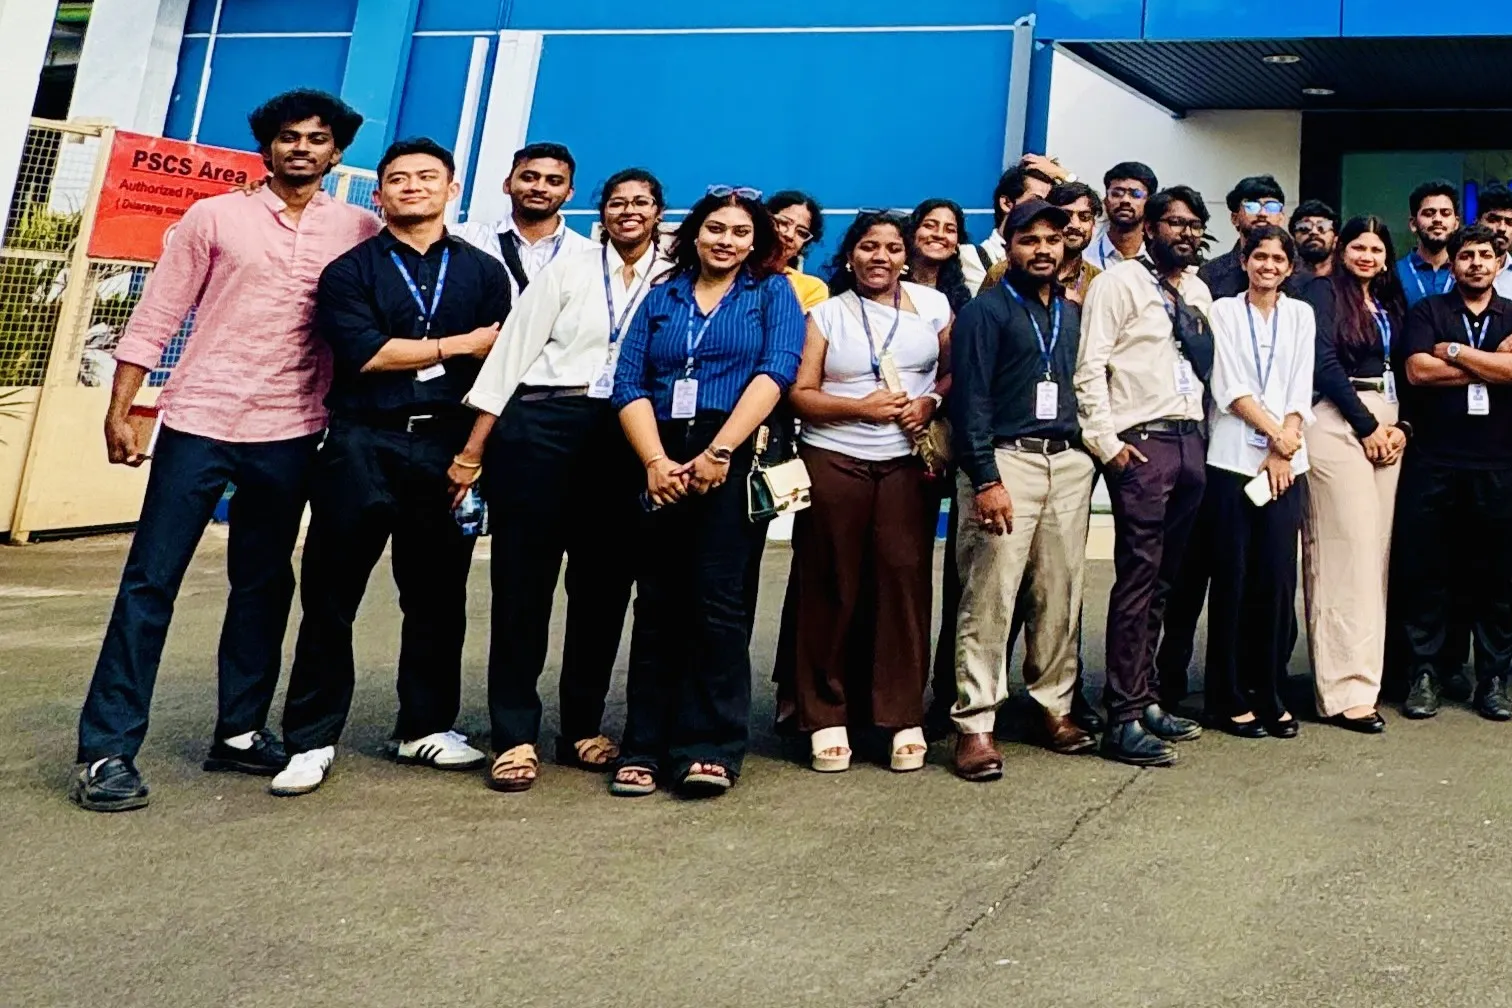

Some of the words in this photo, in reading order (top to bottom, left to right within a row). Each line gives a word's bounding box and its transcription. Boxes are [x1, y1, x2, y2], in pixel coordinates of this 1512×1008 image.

[132, 149, 193, 176] PSCS
[197, 161, 248, 185] Area
[119, 178, 183, 199] Authorized
